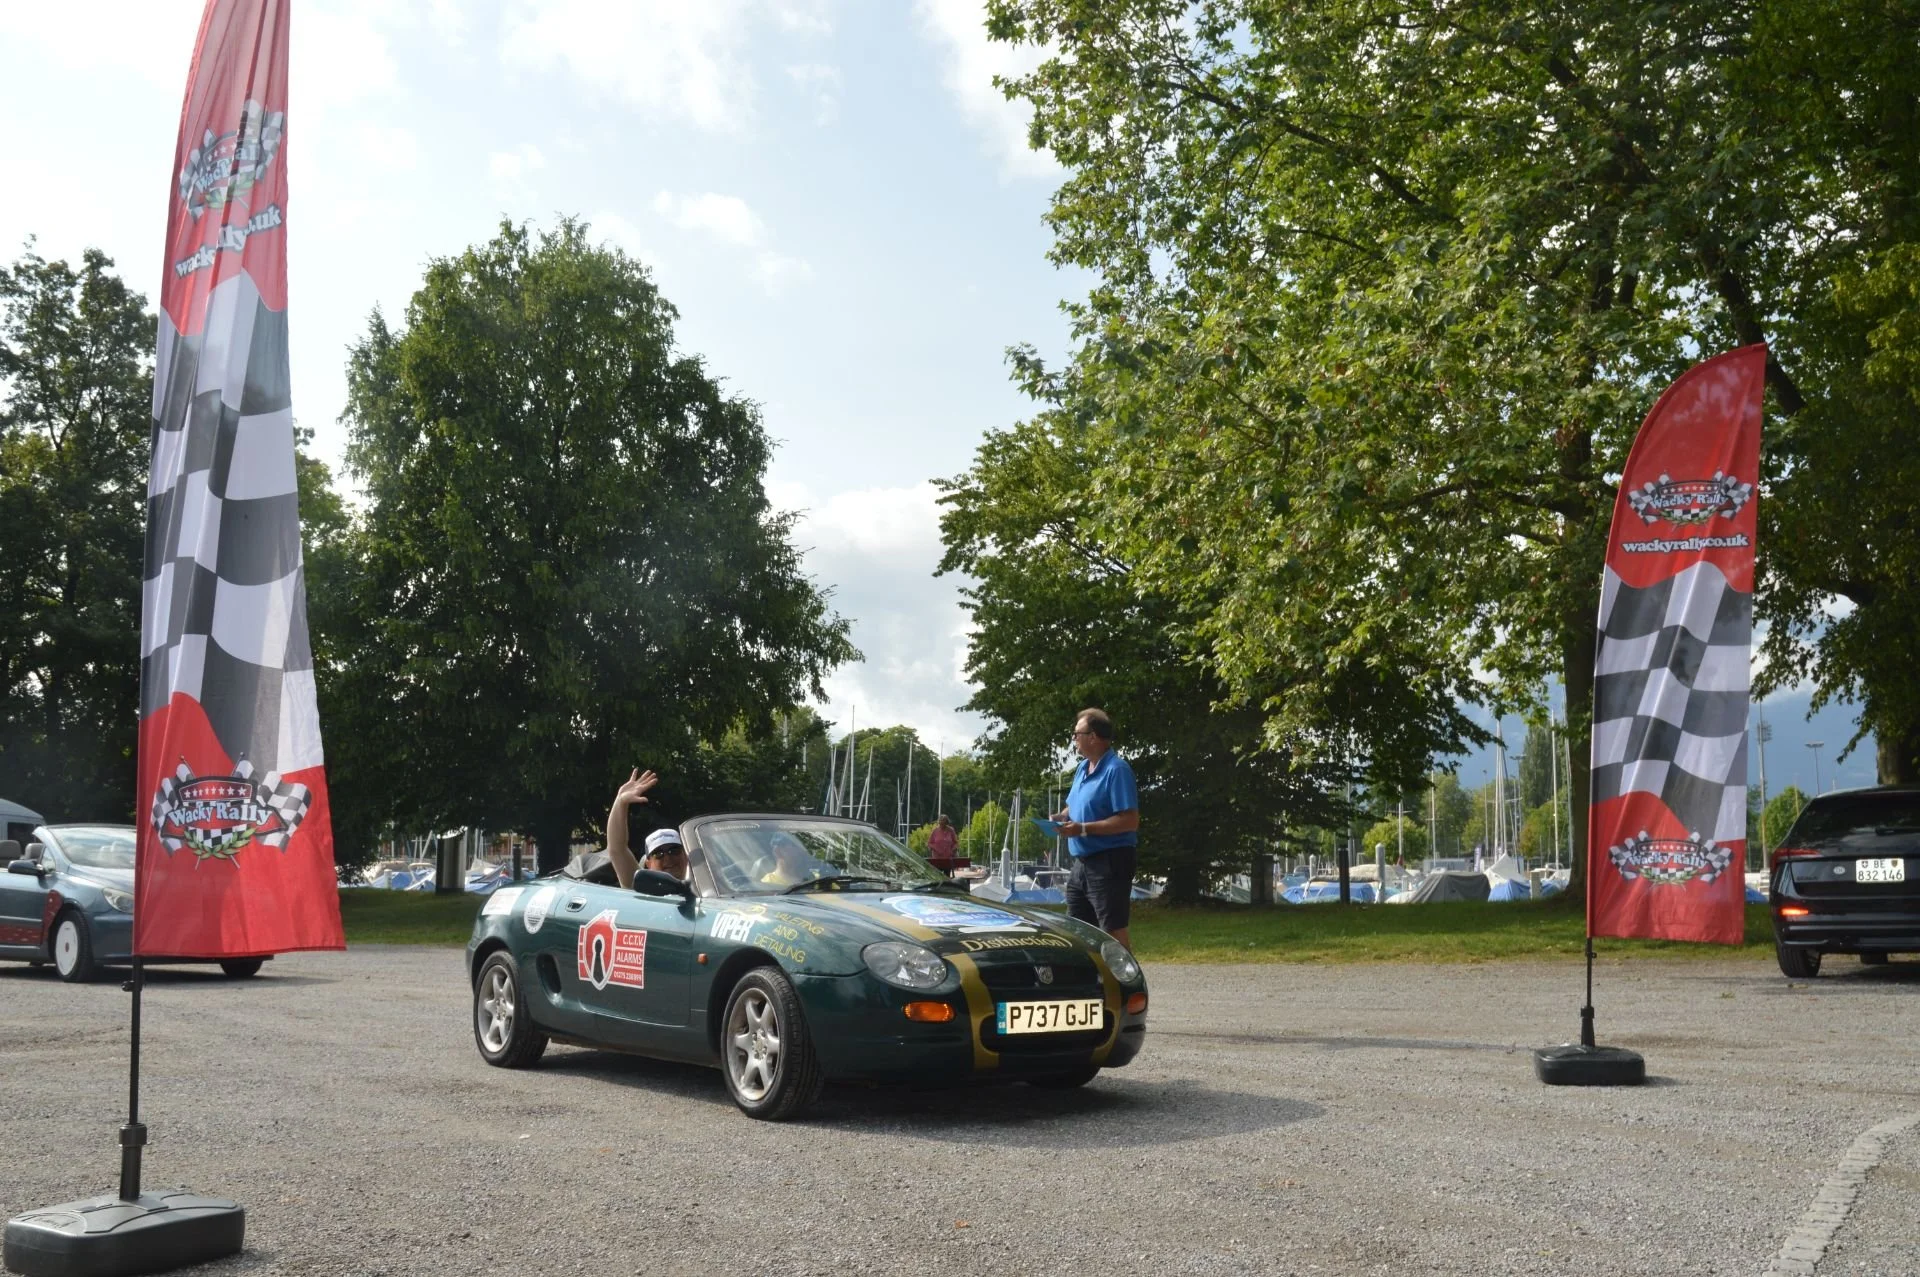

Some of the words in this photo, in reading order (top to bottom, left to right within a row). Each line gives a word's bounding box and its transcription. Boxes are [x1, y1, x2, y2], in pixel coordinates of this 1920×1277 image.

[1651, 494, 1694, 509] Wacky
[1696, 493, 1729, 508] Rally
[168, 801, 212, 826] Wacky
[216, 801, 273, 826] Rally
[1628, 851, 1669, 866] Wacky
[1673, 852, 1708, 868] Rally
[1873, 860, 1886, 869] BE
[710, 912, 756, 942] VIPER
[773, 925, 798, 941] AND
[622, 934, 644, 946] C.C.T.V.
[753, 933, 806, 963] DETAILING
[960, 932, 1070, 951] Distinction
[616, 951, 642, 965] ALARMS
[1010, 1004, 1060, 1029] P737
[1066, 1003, 1100, 1026] GJF
